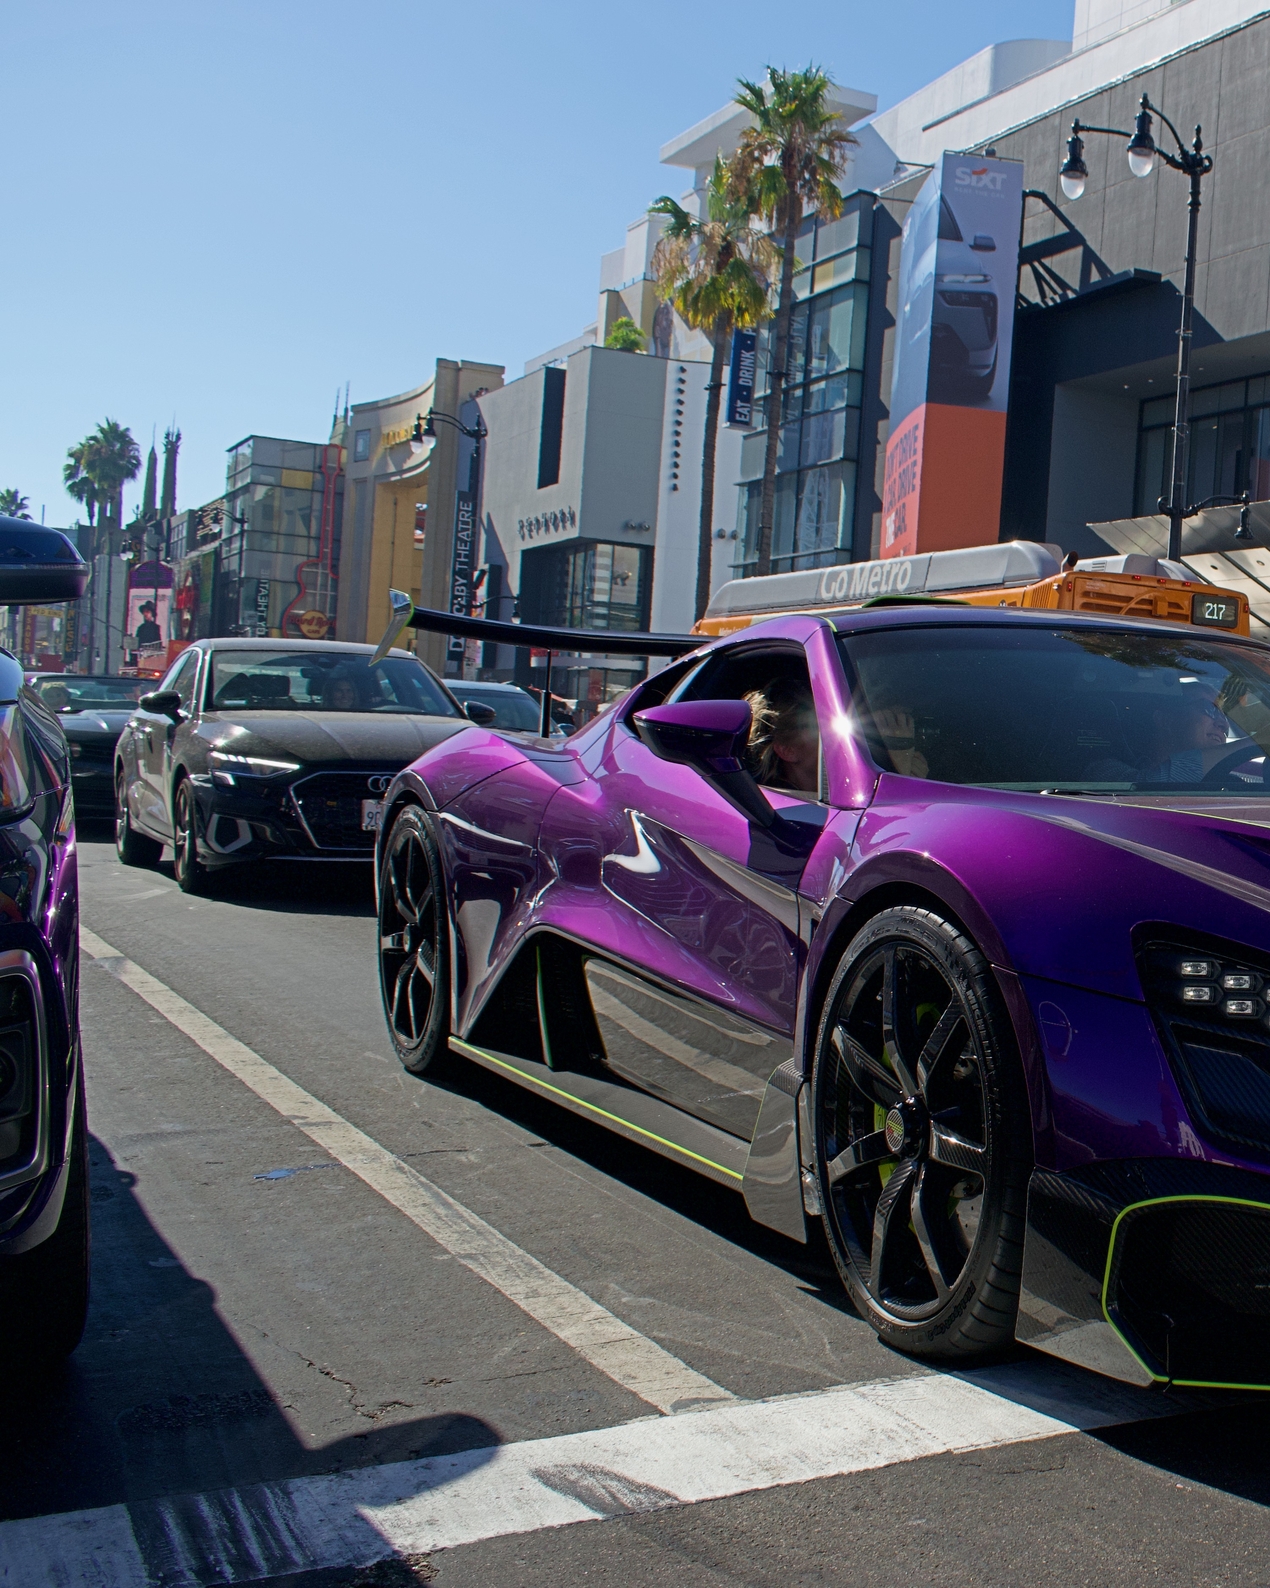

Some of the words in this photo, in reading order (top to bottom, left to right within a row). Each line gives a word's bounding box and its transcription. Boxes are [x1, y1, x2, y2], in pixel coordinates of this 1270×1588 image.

[738, 349, 756, 387] DRINK
[735, 400, 752, 422] EAT
[455, 500, 473, 571] THEATRE
[820, 568, 847, 599] Go
[849, 559, 912, 597] Metro
[1204, 602, 1226, 621] 217
